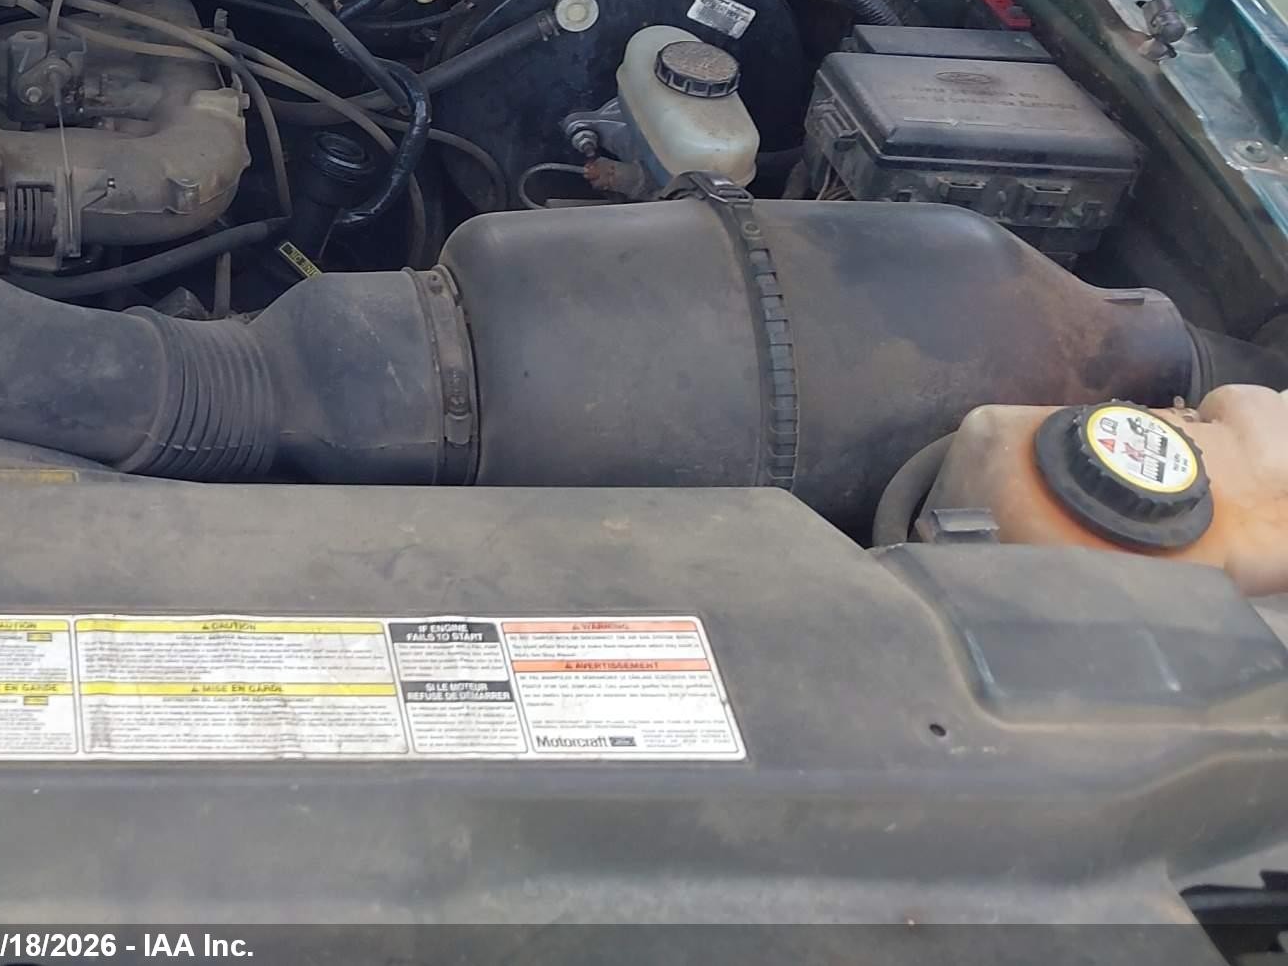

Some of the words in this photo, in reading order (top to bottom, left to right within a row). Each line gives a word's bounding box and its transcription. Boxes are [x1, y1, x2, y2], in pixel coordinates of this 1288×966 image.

[212, 622, 257, 630] CAUTION
[418, 625, 428, 633] IF
[430, 624, 469, 633] ENGINE
[406, 633, 435, 641] FAILS
[437, 633, 450, 641] TO
[452, 633, 483, 641] START
[202, 684, 228, 692] MISE
[232, 684, 245, 692] EN
[425, 684, 435, 692] SI
[437, 683, 448, 691] LE
[450, 683, 488, 691] MOTEUR
[407, 692, 443, 701] REFUSE
[445, 692, 457, 701] DE
[536, 735, 608, 748] Motorcraft
